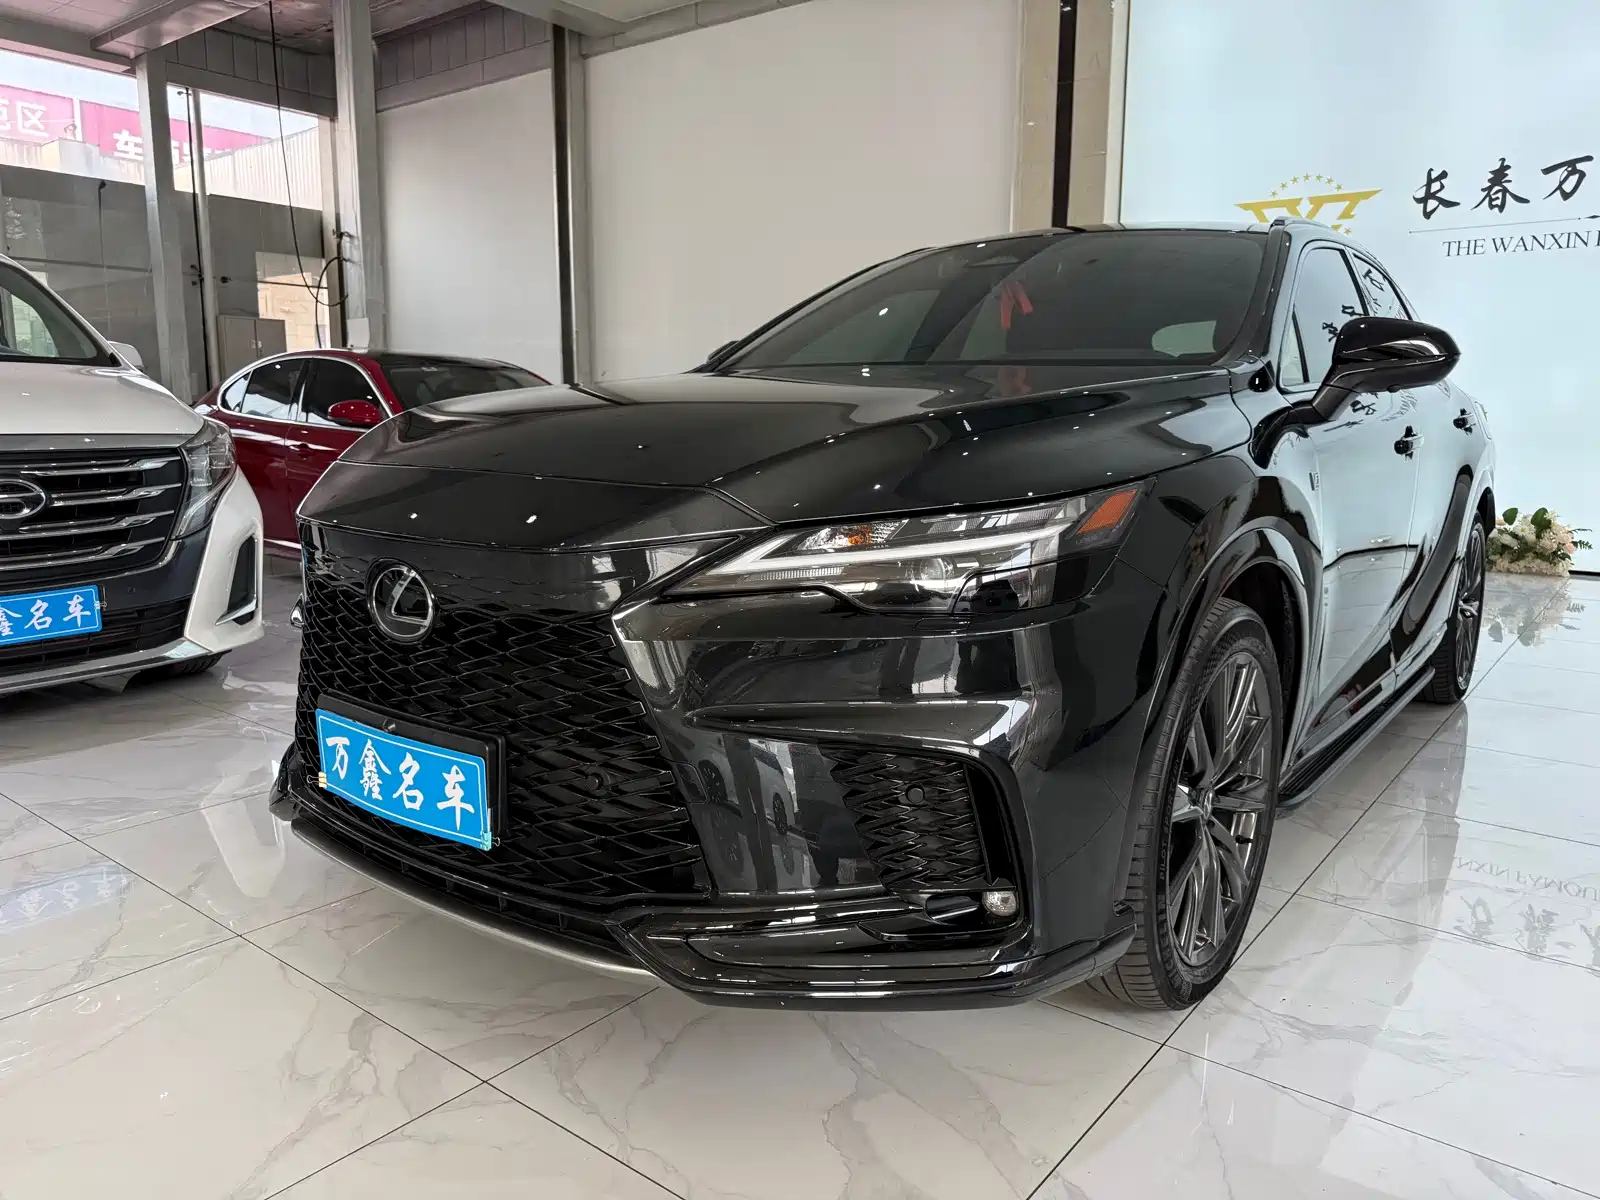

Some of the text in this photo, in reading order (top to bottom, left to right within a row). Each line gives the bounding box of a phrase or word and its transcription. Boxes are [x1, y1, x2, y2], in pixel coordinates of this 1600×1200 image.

[1412, 155, 1594, 220] 长春万
[1442, 238, 1485, 256] THE
[1492, 230, 1592, 253] WANXIN
[326, 736, 475, 831] 万鑫名车
[1160, 840, 1168, 881] PILOT
